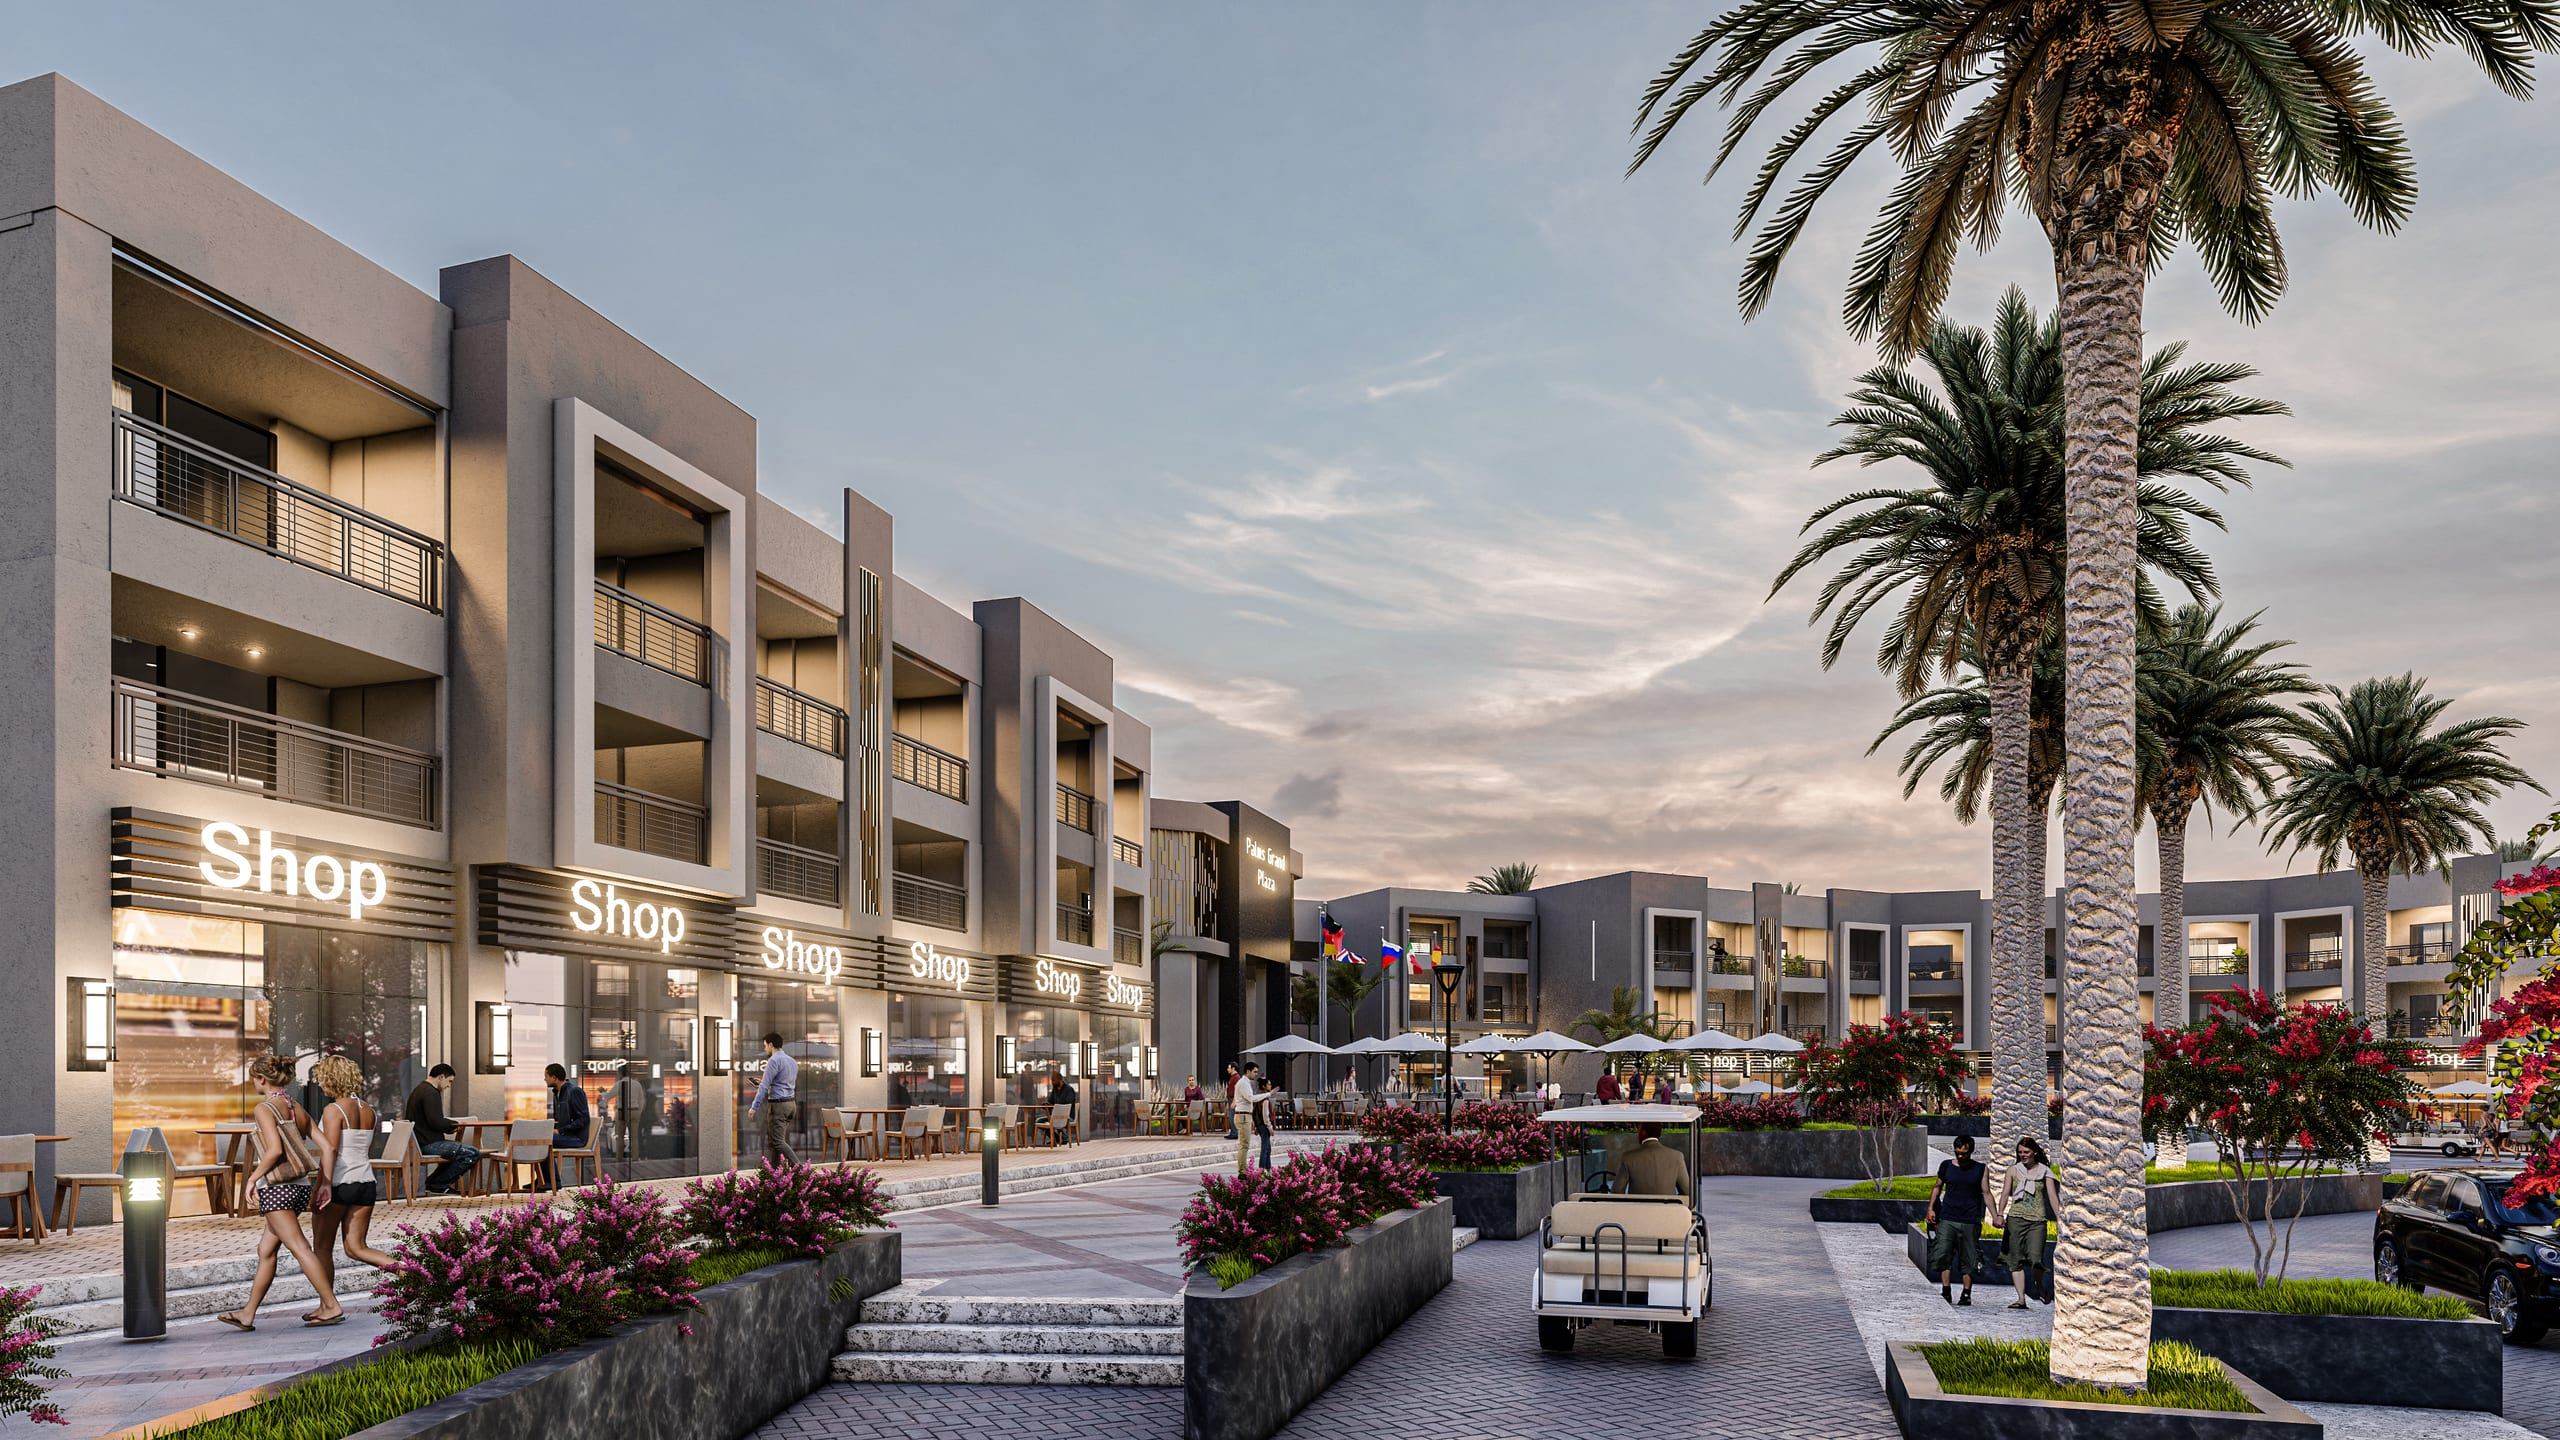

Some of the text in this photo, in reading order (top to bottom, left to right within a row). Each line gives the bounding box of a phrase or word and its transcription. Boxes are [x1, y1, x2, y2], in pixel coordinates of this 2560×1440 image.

[199, 820, 388, 920] Shop
[1246, 836, 1286, 871] Palms Grand
[1257, 868, 1276, 892] Plaza
[570, 879, 685, 954] Shop
[761, 926, 842, 985] Shop
[910, 941, 970, 991] Shop
[1035, 959, 1081, 1003] Shop
[1106, 974, 1143, 1012] Shop
[2413, 1049, 2467, 1069] hop
